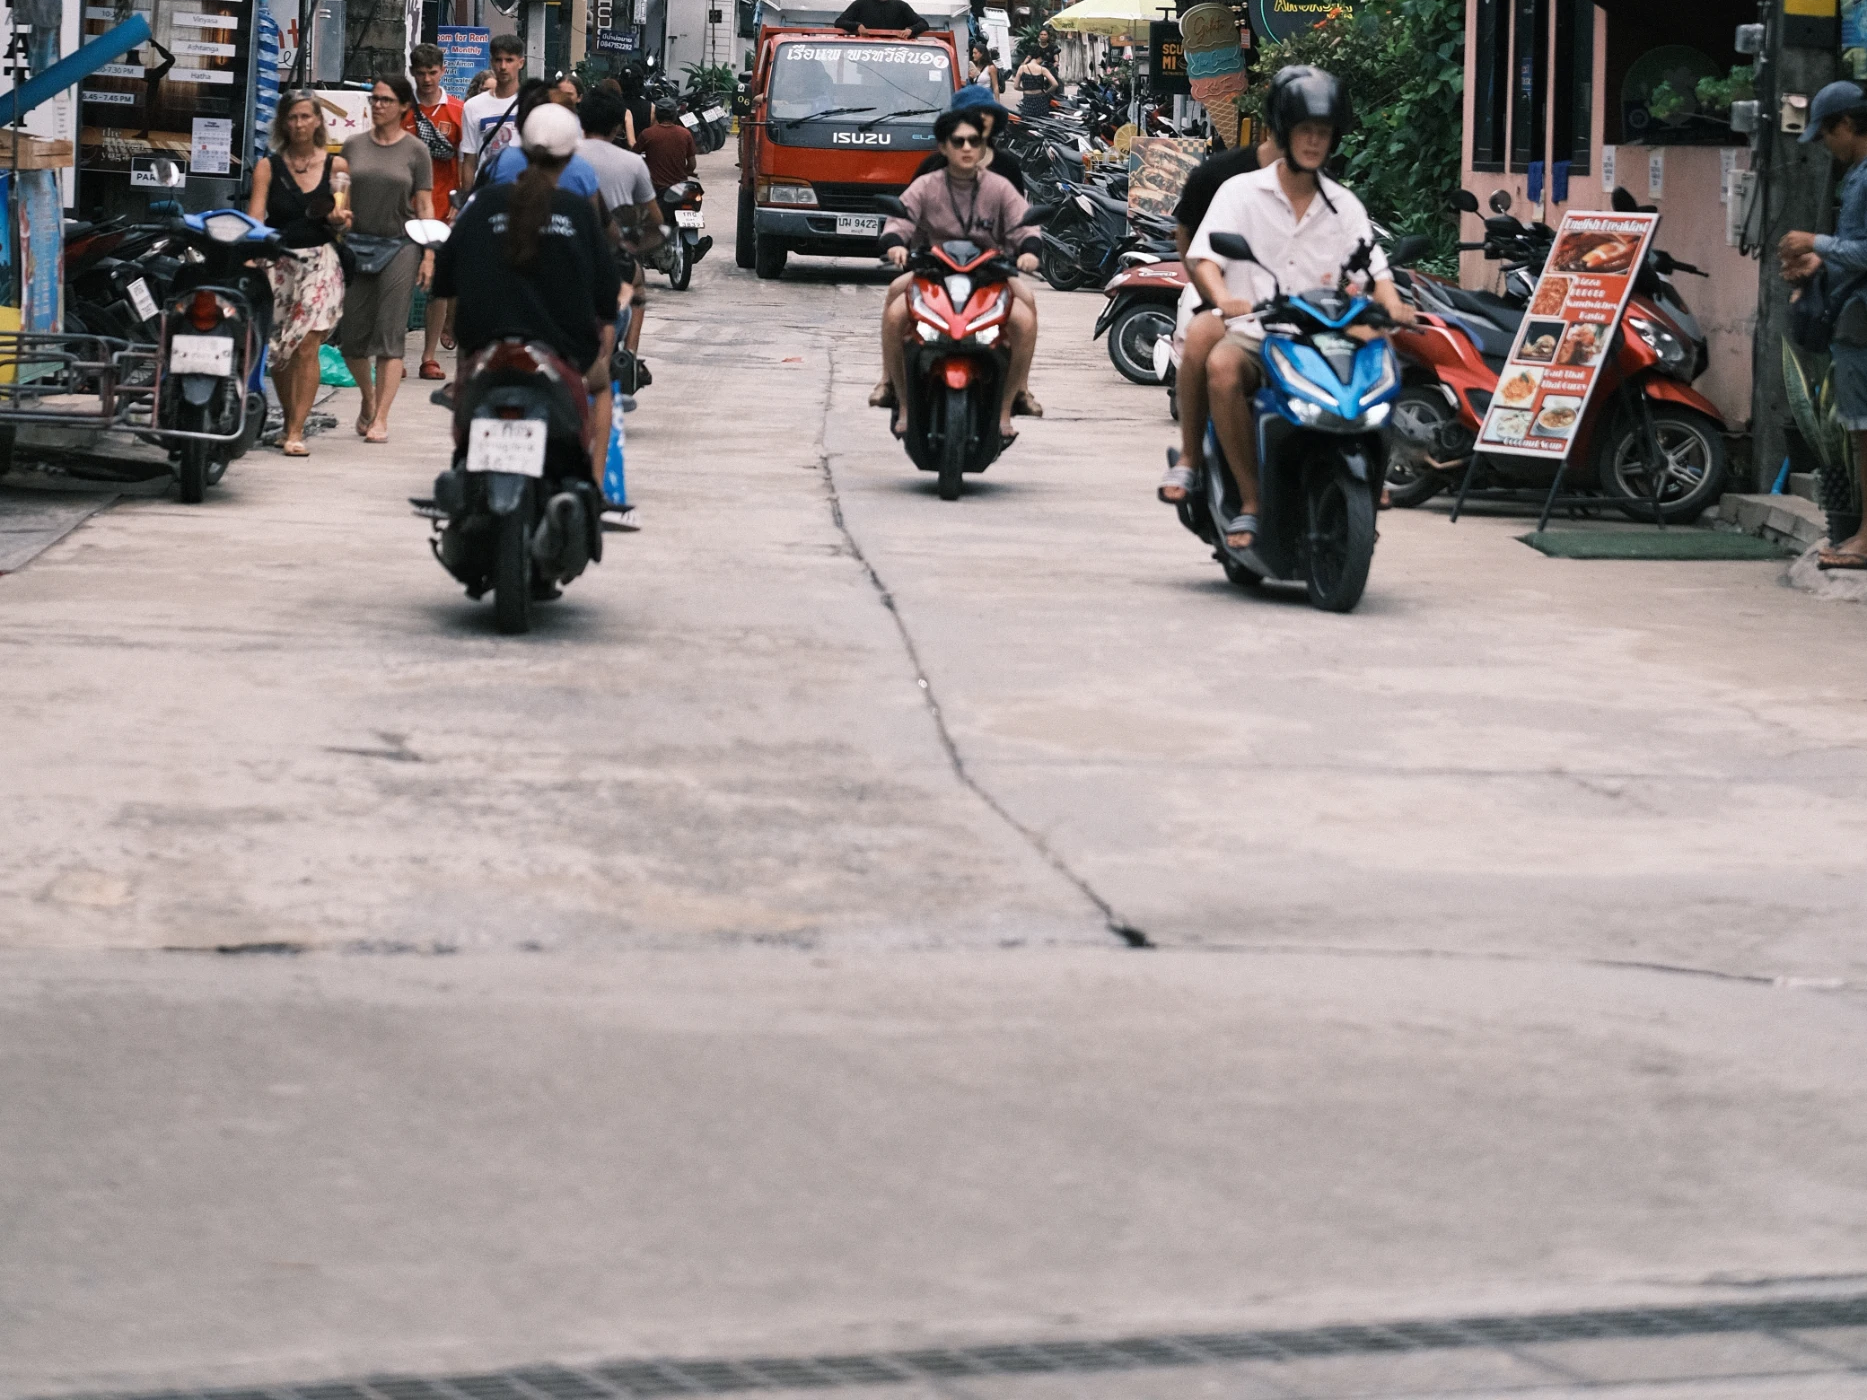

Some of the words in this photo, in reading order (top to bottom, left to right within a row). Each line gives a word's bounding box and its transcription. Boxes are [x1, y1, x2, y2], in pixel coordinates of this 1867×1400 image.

[192, 15, 219, 26] Vinyasa
[437, 33, 453, 42] oom
[455, 33, 467, 42] for
[469, 33, 489, 42] Rent
[187, 43, 219, 53] Ashtanga
[937, 57, 945, 67] 7
[123, 67, 134, 75] PM
[190, 72, 212, 81] Hatha
[104, 94, 119, 102] 7.45
[737, 95, 750, 107] 06
[832, 131, 891, 145] ISUZU
[854, 218, 877, 229] 9422
